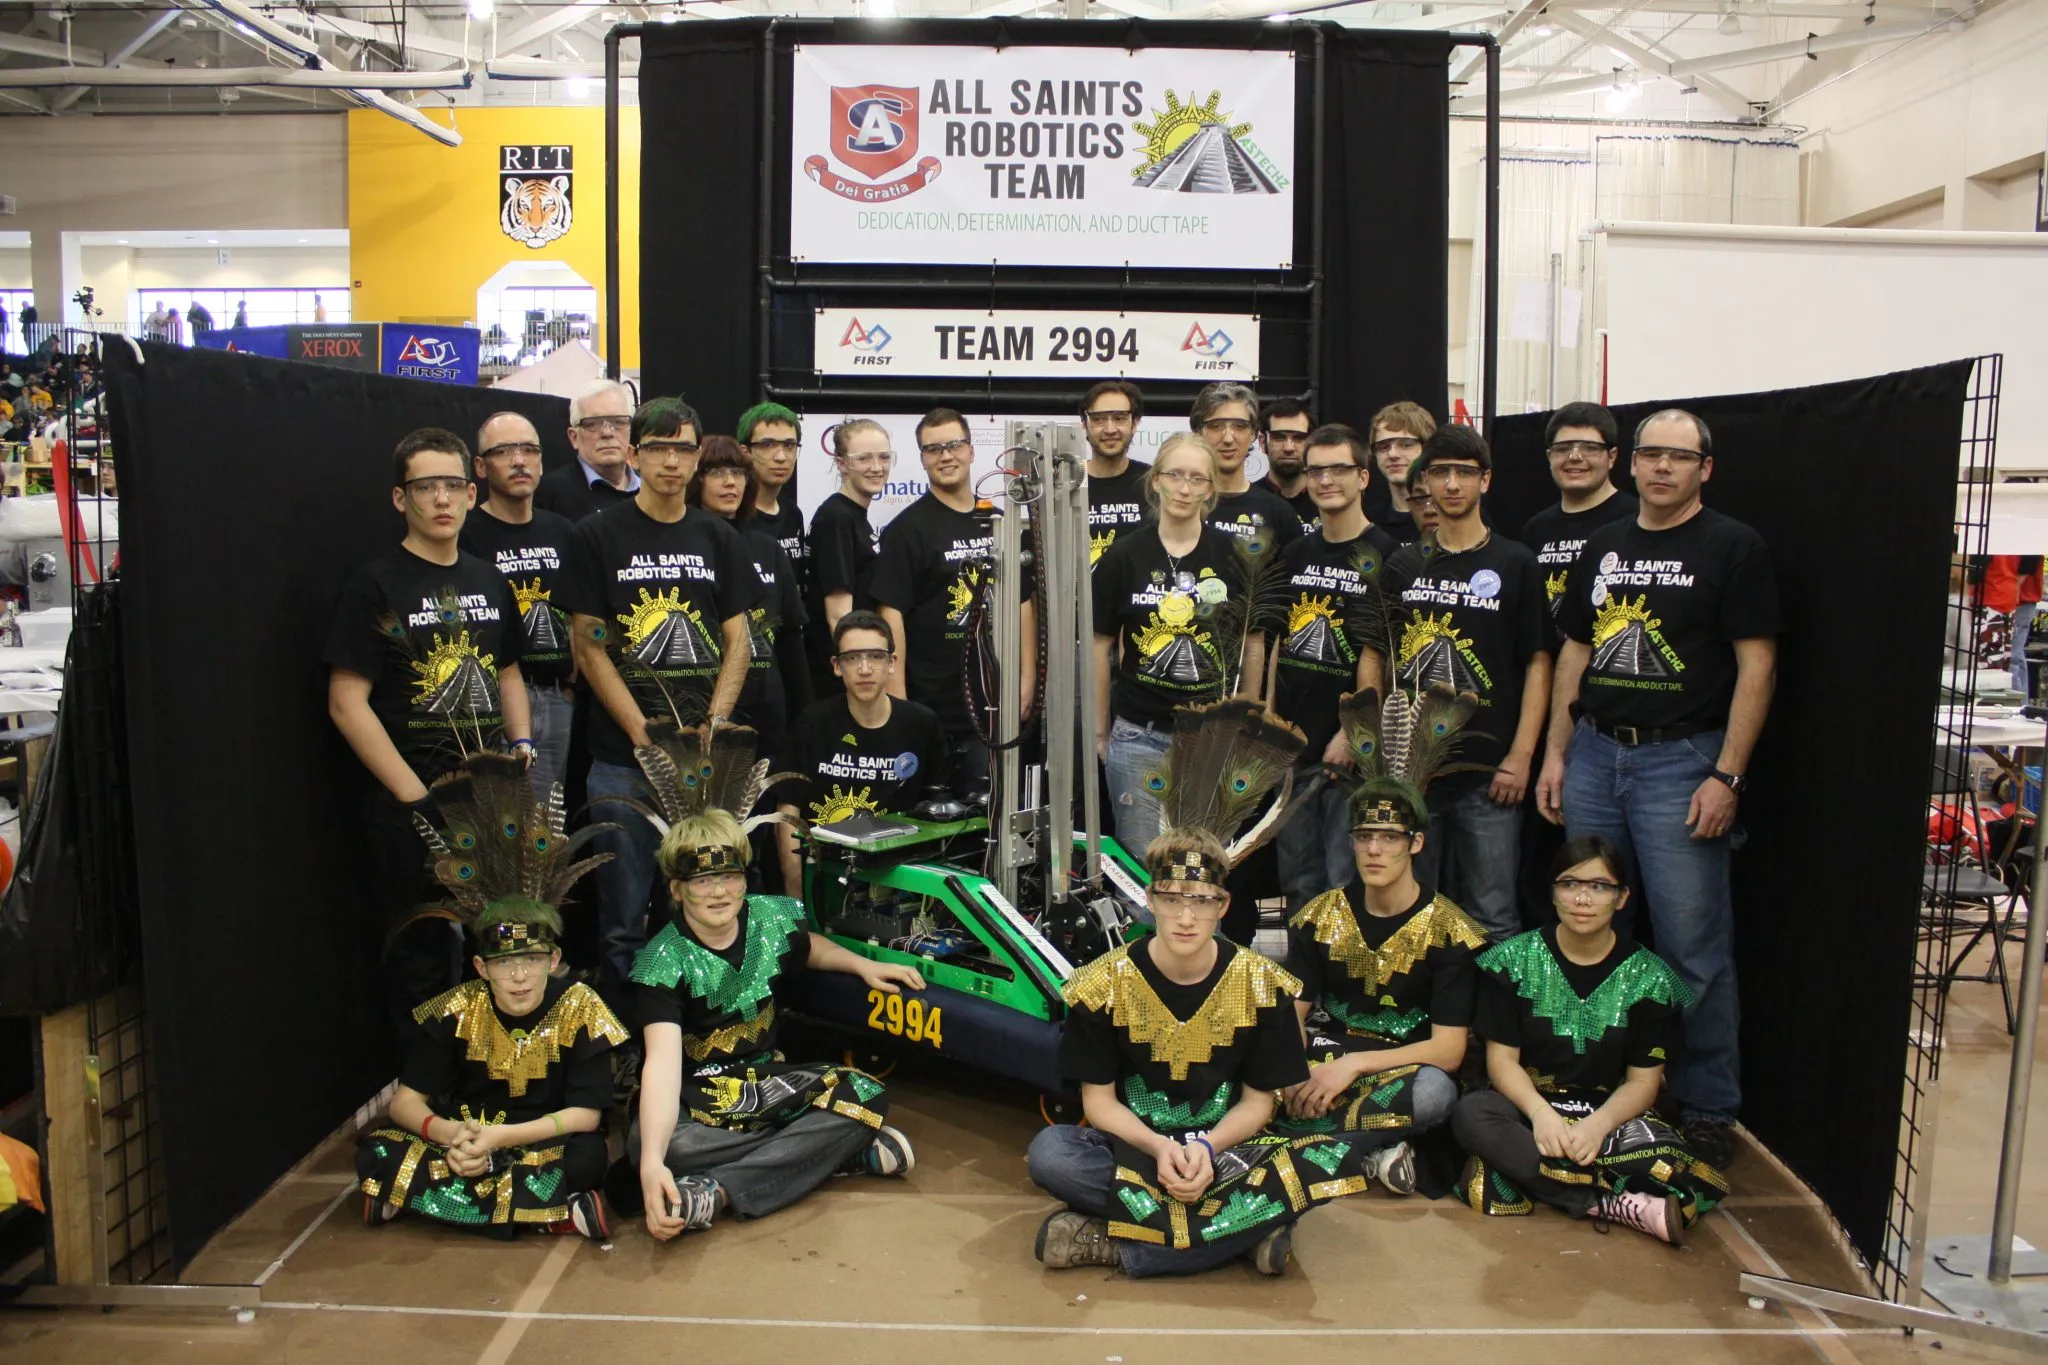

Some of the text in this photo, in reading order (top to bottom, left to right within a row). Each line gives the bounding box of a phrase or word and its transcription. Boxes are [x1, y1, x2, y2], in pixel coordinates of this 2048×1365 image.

[928, 79, 1143, 117] ALL SAINTS
[945, 121, 1124, 159] ROBOTICS
[1237, 136, 1290, 190] ASTECHZ
[984, 163, 1085, 200] TEAM
[834, 180, 910, 200] Dei Gratia
[857, 211, 1209, 235] DEDICATION, DETERMINATION, AND DUCT TAPE
[302, 339, 364, 358] XEROX
[934, 325, 1140, 363] TEAM 2994
[853, 355, 894, 366] FIRST
[1194, 360, 1235, 371] FIRST
[398, 365, 461, 380] FIRST
[1101, 503, 1140, 513] SAINTS
[1088, 513, 1141, 524] OTICS TEA
[1214, 521, 1256, 535] SAINTS
[779, 537, 799, 549] AINTS
[952, 540, 969, 550] ALL
[1541, 542, 1556, 553] ALL
[496, 547, 558, 562] ALL SAINTS
[630, 554, 704, 567] ALL SAINTS
[790, 548, 802, 559] TEA
[543, 558, 561, 569] TEA
[1633, 560, 1683, 573] SAINTS
[617, 566, 715, 582] ROBOTICS TEAM
[1303, 564, 1360, 582] ALL SAINTS
[1594, 573, 1695, 588] ROBOTICS TEAM
[1145, 583, 1166, 594] ALL
[1291, 575, 1368, 596] ROBOTICS TEAM
[1412, 577, 1435, 590] ALL
[1439, 579, 1472, 594] SAIN
[1401, 589, 1500, 611] ROBOTICS TEAM
[469, 607, 500, 621] TEAM
[1649, 629, 1687, 673] ASTECHZ
[1460, 648, 1494, 690] ASTECHZ
[1636, 681, 1650, 689] AND
[1651, 681, 1667, 691] DUCT
[831, 752, 855, 767] ALL
[858, 756, 895, 769] SAINT
[818, 762, 877, 781] ROBOTICS
[867, 988, 943, 1049] 2994
[1604, 1148, 1657, 1165] DETERMINATION,
[1656, 1145, 1671, 1155] AND
